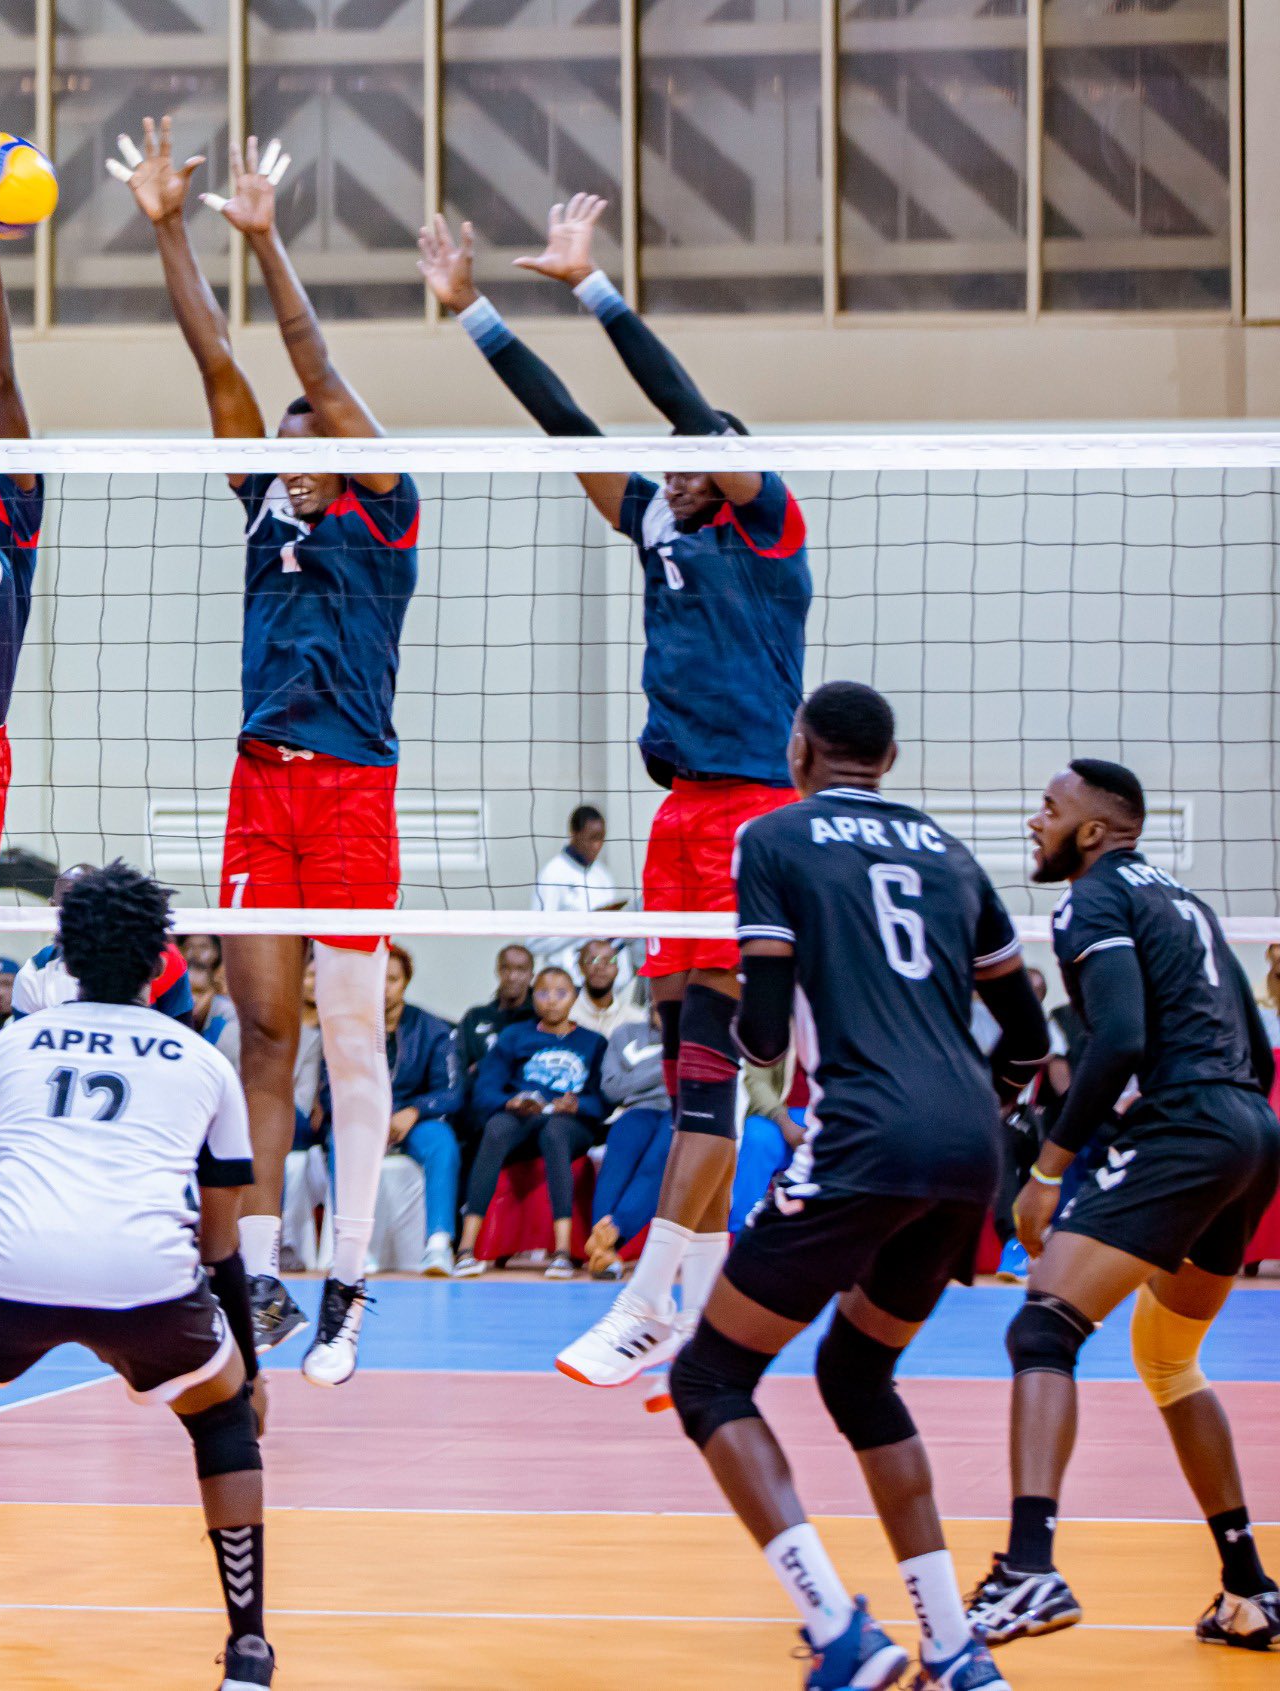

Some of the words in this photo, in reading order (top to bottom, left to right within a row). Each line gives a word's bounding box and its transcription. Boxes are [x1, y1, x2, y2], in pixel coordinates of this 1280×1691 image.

[810, 816, 894, 848] APR
[890, 820, 947, 853] VC
[229, 872, 250, 909] 7
[868, 863, 933, 980] 6
[1171, 899, 1219, 987] 7
[29, 1028, 114, 1055] APR
[131, 1036, 184, 1061] VC
[45, 1065, 132, 1122] 12
